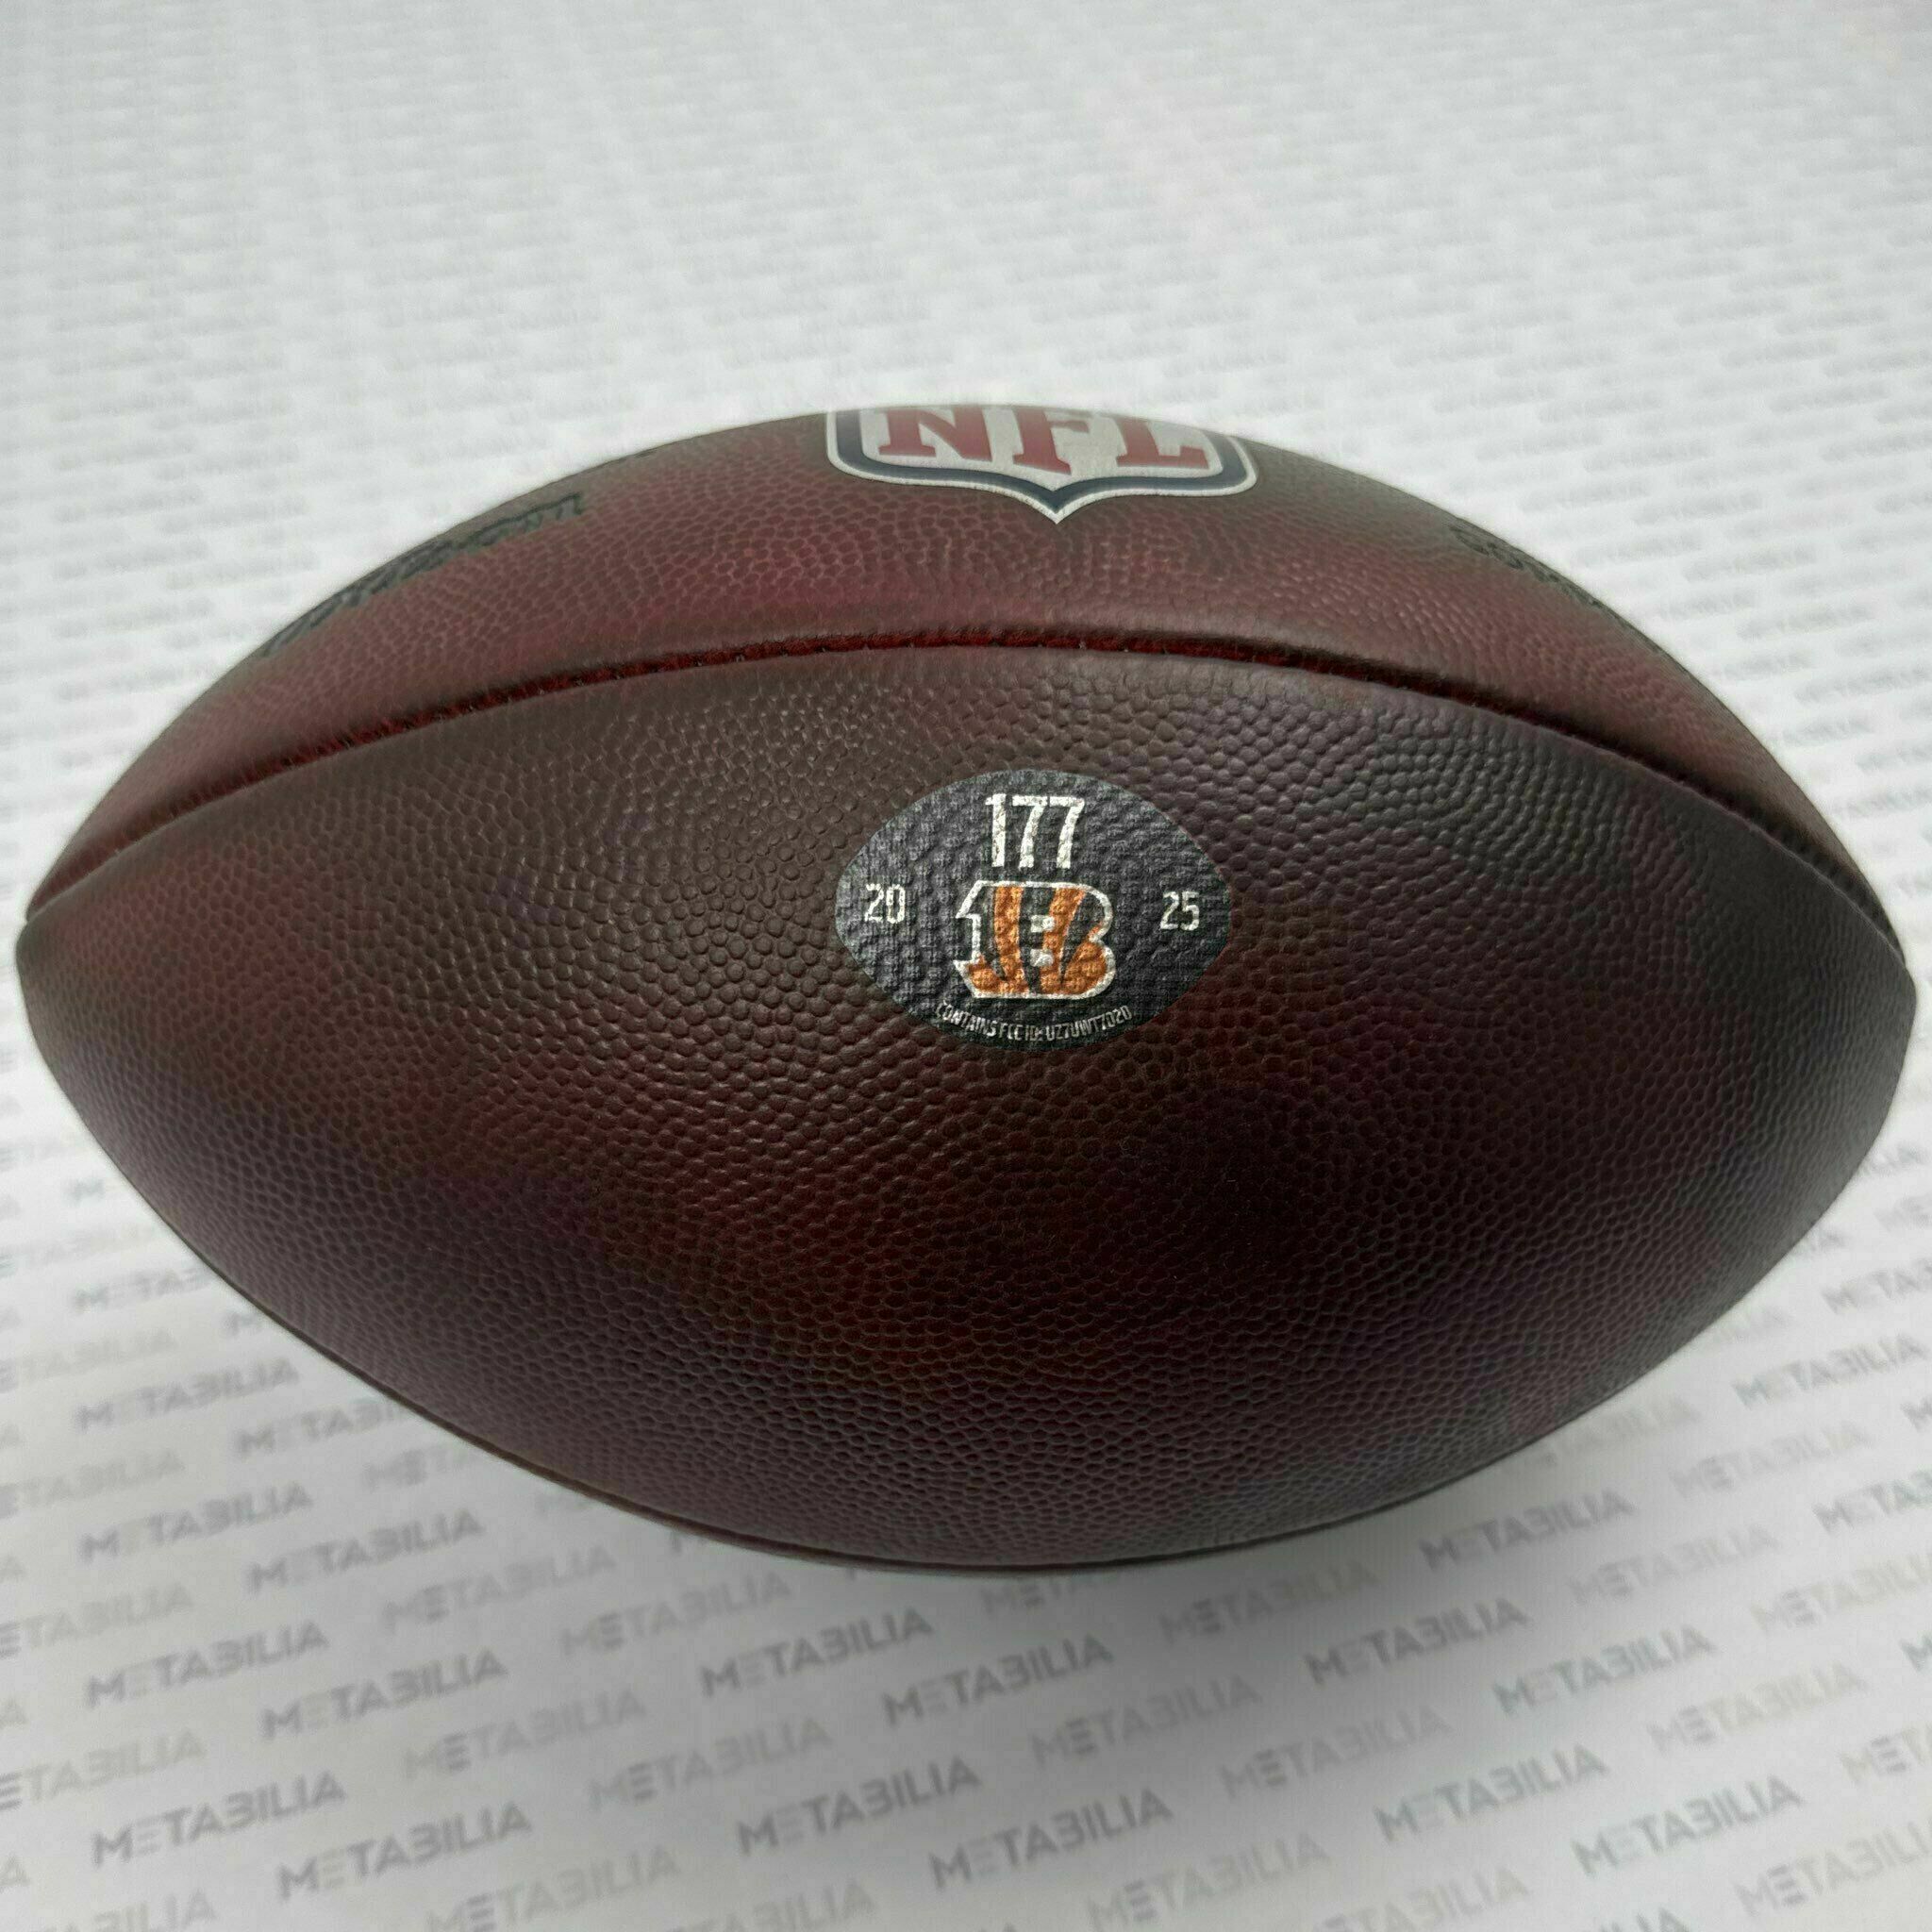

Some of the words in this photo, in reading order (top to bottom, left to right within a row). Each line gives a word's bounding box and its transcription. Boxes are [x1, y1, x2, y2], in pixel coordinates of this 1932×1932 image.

[874, 407, 1209, 475] NFL
[986, 793, 1085, 869] 177
[864, 884, 906, 924] 20
[1159, 891, 1200, 931] 25
[935, 1002, 997, 1037] CONTAINS
[999, 1022, 1024, 1041] FCC
